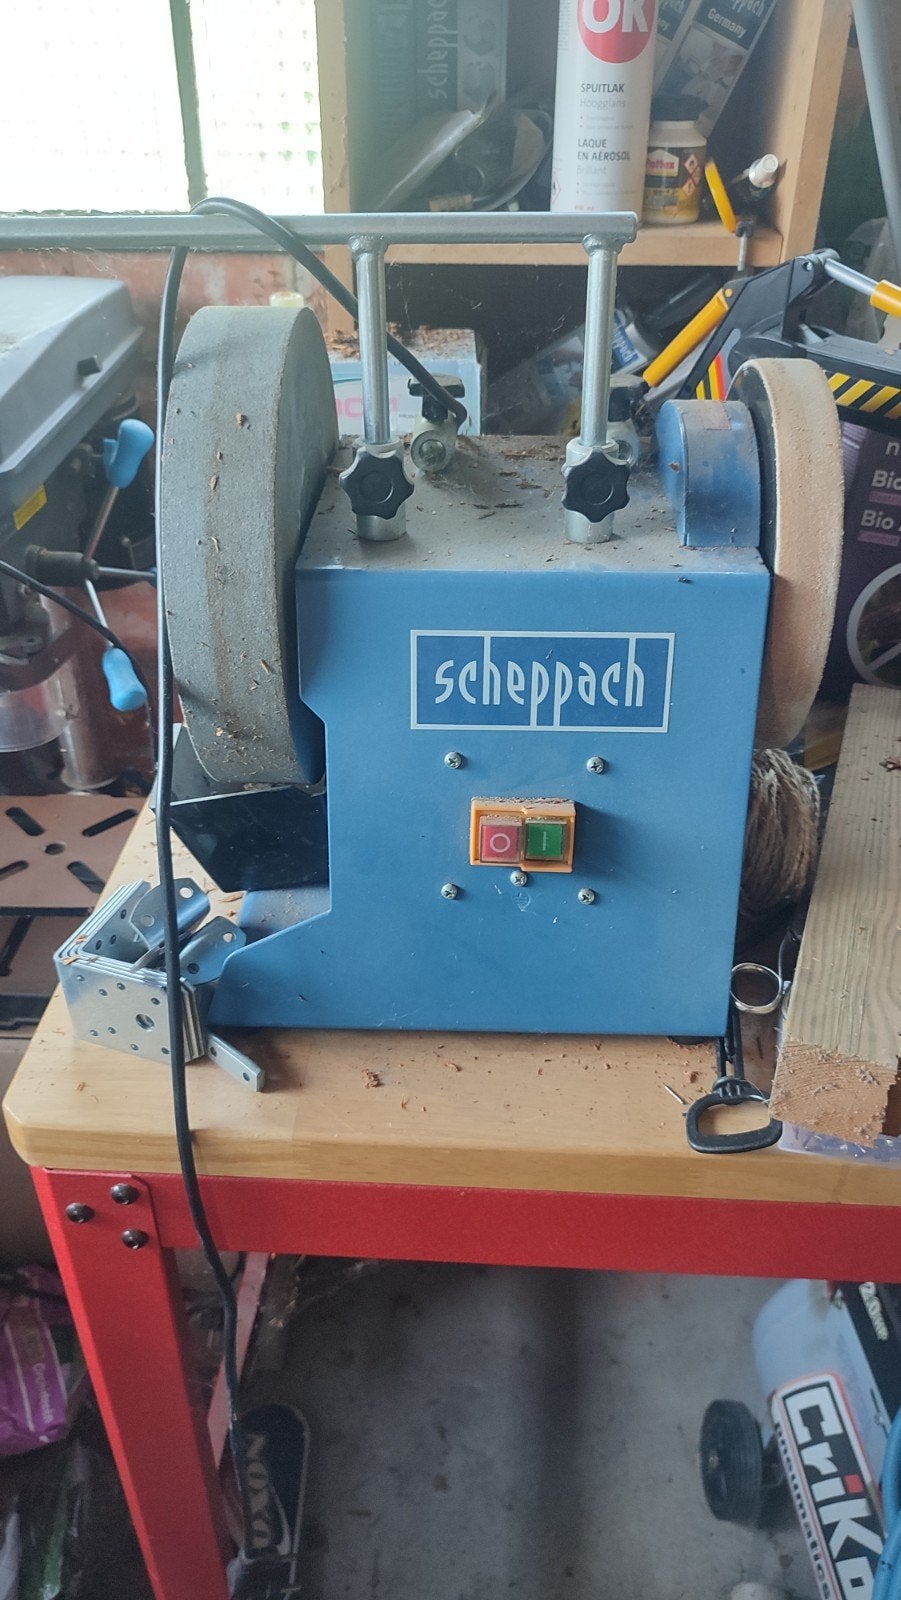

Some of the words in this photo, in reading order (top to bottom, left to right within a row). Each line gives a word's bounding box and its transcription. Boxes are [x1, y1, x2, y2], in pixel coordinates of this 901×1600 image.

[583, 0, 648, 33] OK
[707, 8, 747, 38] Germany
[580, 83, 625, 93] SPUITLAK
[577, 138, 607, 148] LAQUE
[577, 151, 589, 160] EN
[591, 150, 631, 161] AÉROSOL
[860, 509, 894, 530] Bio
[434, 635, 646, 727] scheppach
